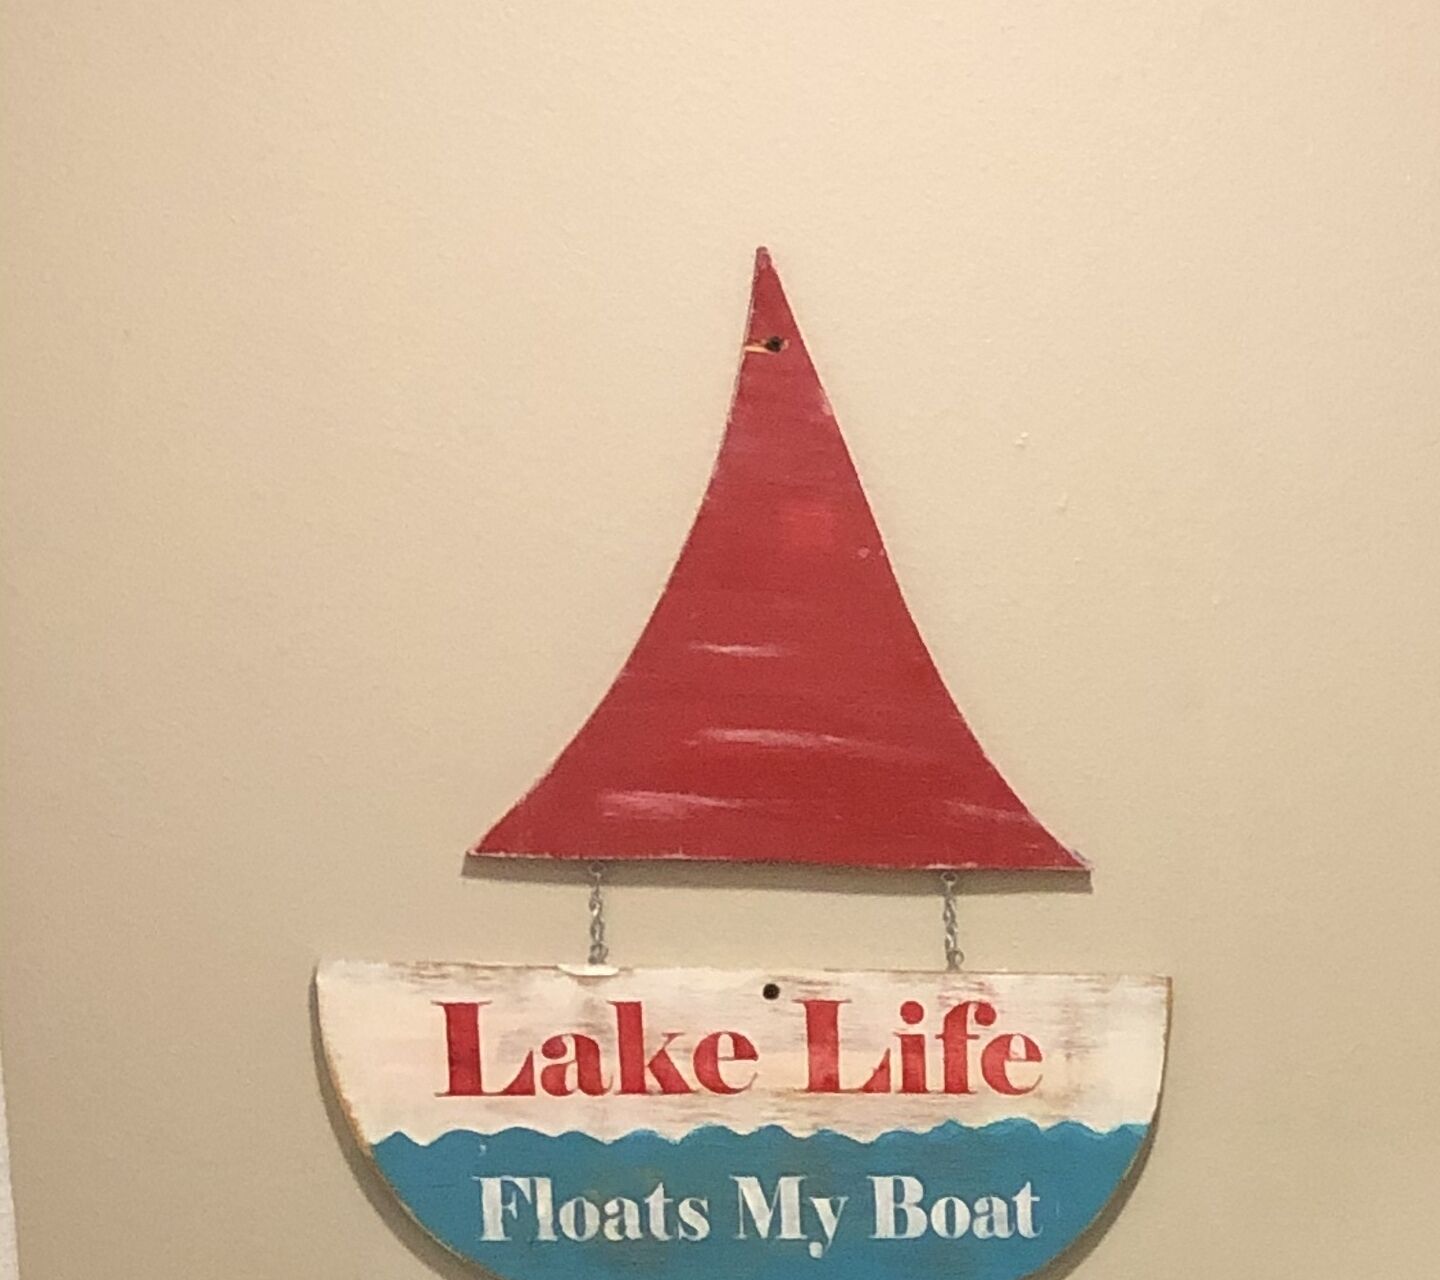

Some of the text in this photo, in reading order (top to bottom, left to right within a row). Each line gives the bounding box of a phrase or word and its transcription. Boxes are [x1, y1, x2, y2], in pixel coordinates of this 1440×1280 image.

[434, 998, 1044, 1098] Lake Life
[473, 1173, 1042, 1260] Floats My Boat
